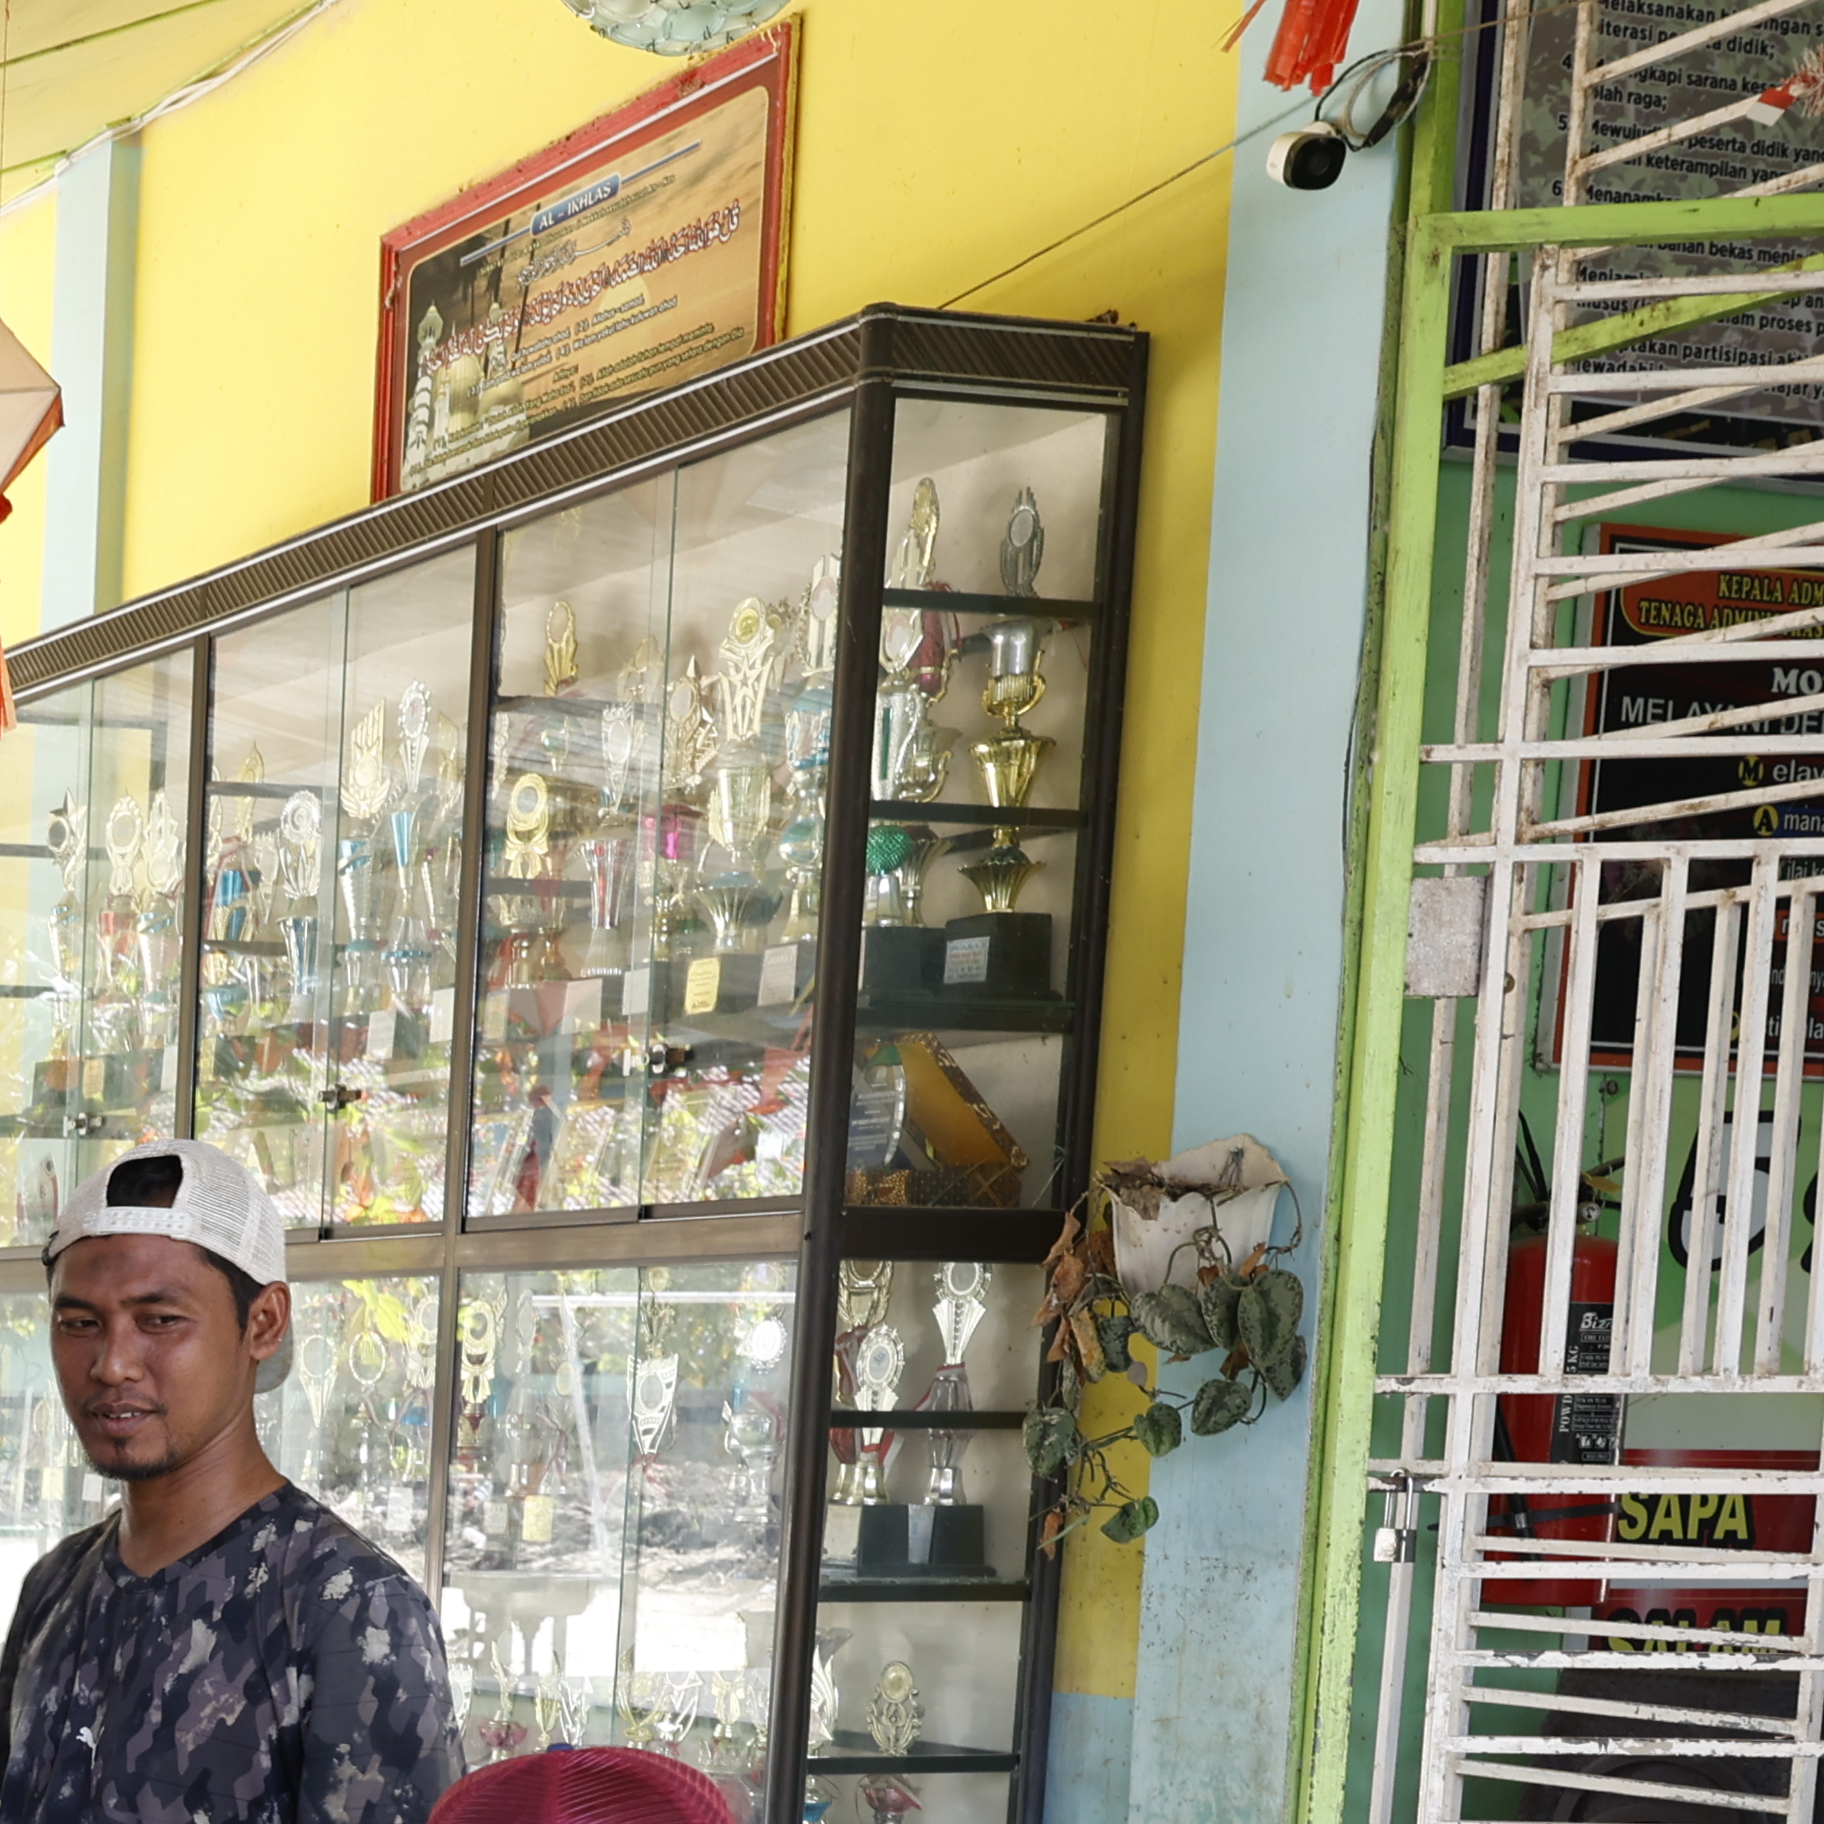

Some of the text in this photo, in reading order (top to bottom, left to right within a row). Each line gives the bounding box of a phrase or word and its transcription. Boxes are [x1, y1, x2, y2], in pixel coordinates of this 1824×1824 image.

[1687, 72, 1738, 91] sarana
[1627, 87, 1667, 109] raga;
[1750, 139, 1789, 159] didik
[1645, 153, 1748, 179] keterampilan
[538, 211, 556, 231] AL
[566, 182, 612, 218] IKHLAS
[1709, 240, 1753, 262] bekas
[1758, 315, 1813, 337] proses
[1682, 340, 1773, 366] partisipasi
[1718, 572, 1785, 604] KEPALA
[1639, 600, 1706, 630] TENAGA
[1567, 1345, 1579, 1364] KG
[1618, 1493, 1751, 1542] SAPA
